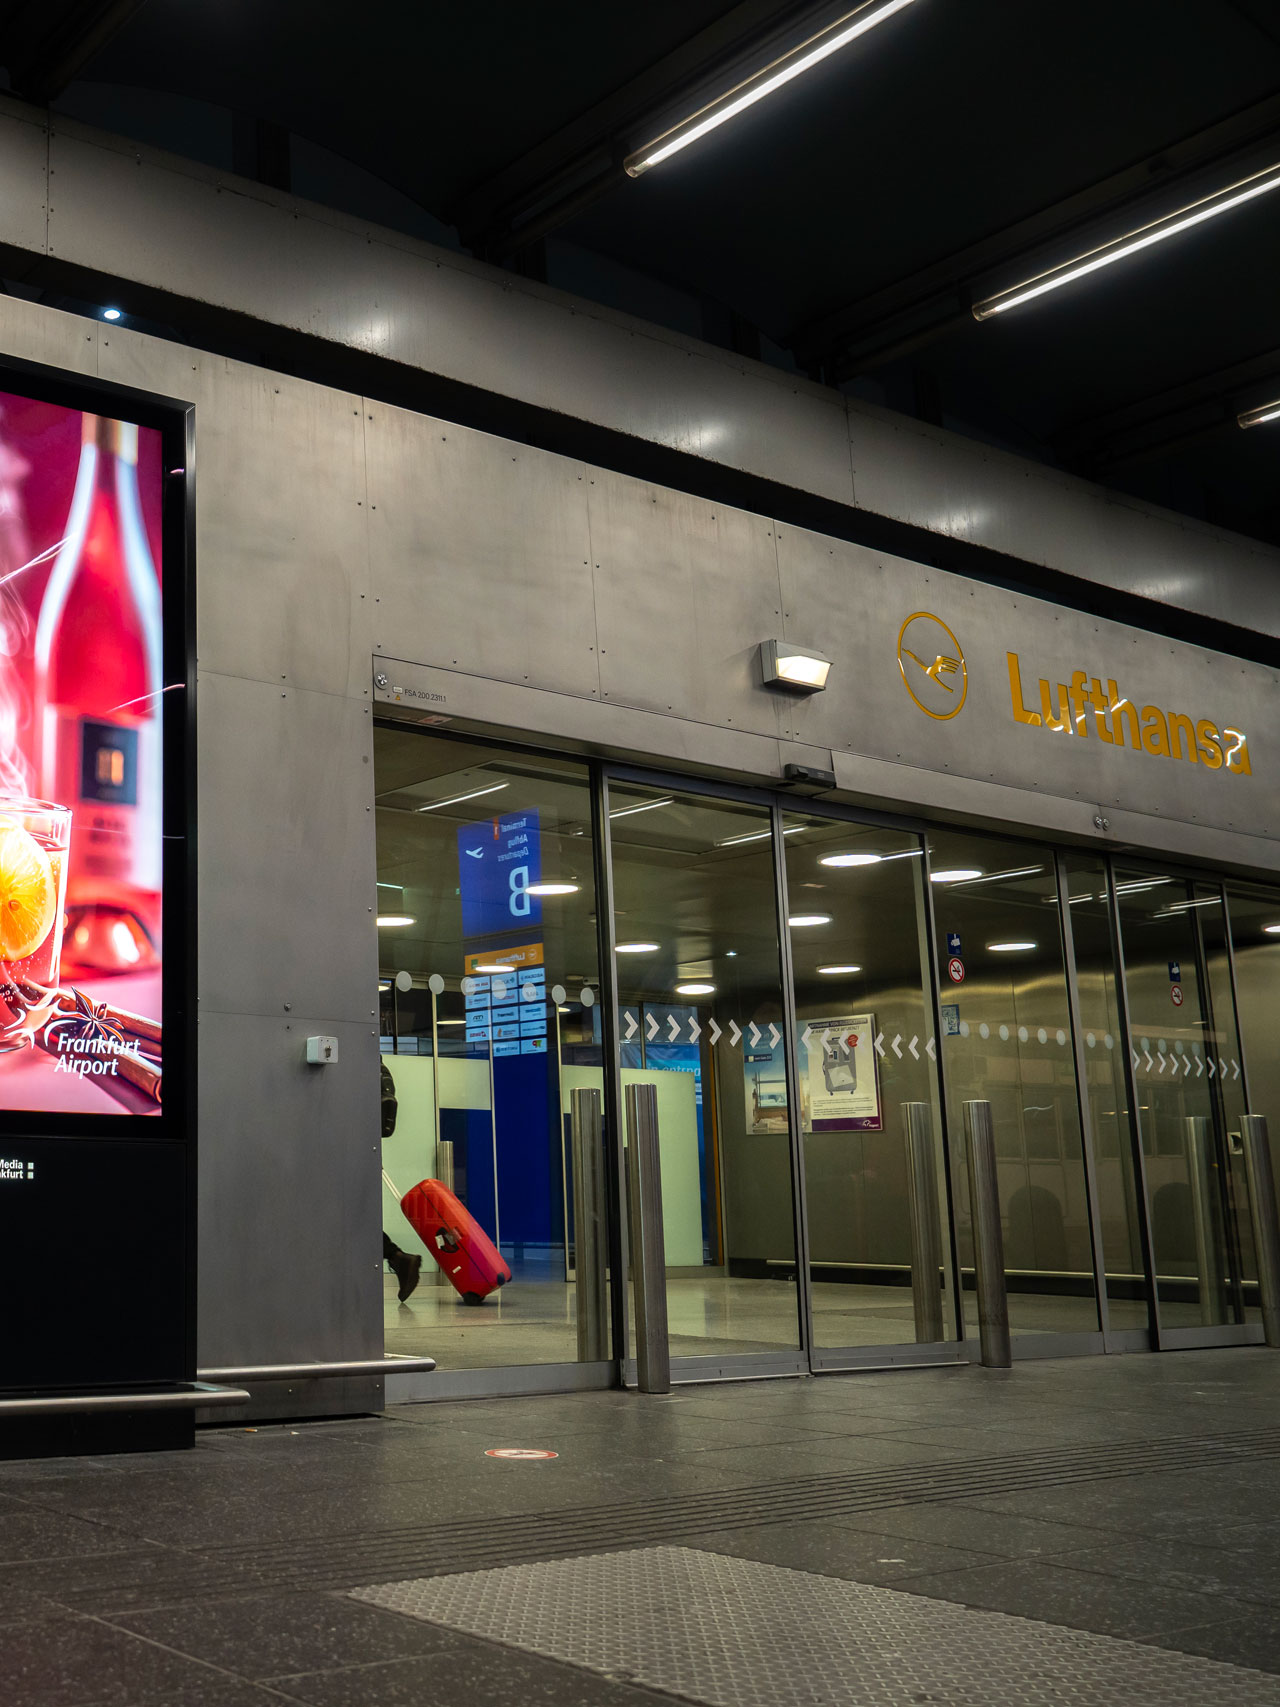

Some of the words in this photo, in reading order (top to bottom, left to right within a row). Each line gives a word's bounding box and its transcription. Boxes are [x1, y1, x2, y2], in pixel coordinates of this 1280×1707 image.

[404, 689, 417, 697] FSA
[417, 691, 430, 700] 200
[1006, 651, 1252, 776] Lufthansa
[57, 1033, 141, 1056] Frankfurt
[54, 1054, 119, 1080] Airport
